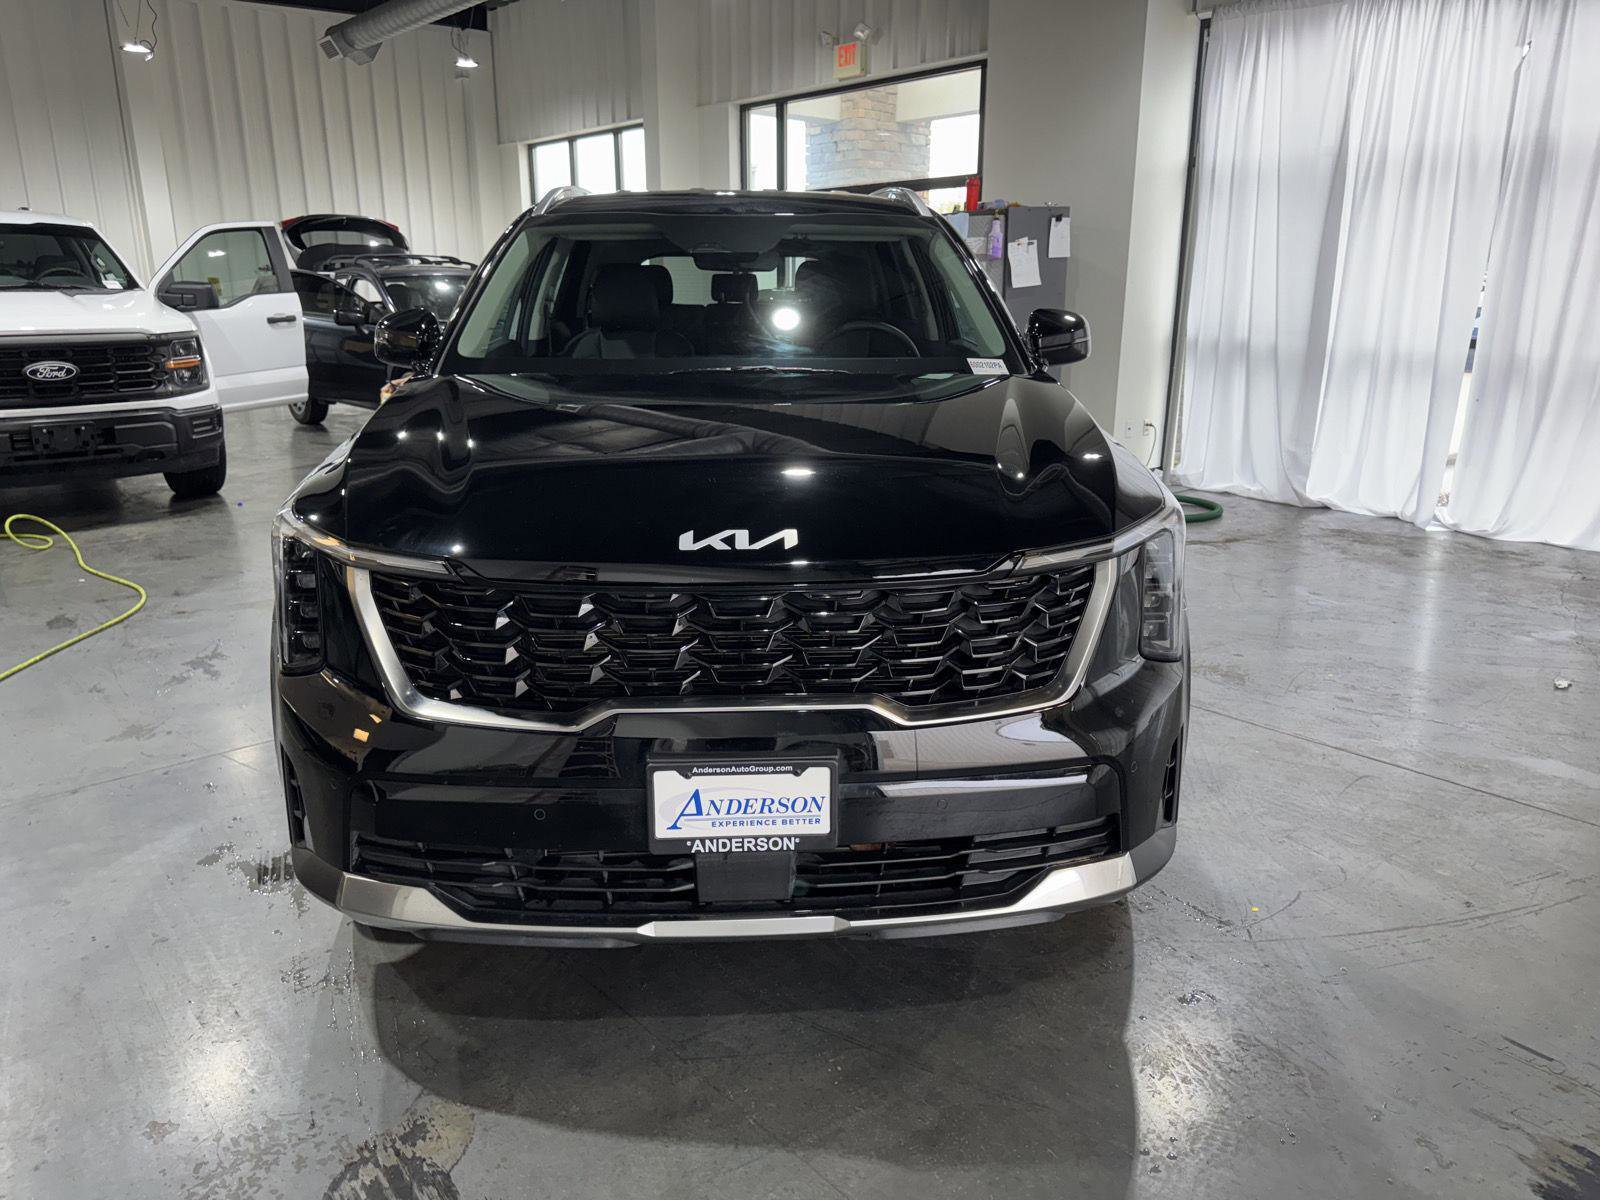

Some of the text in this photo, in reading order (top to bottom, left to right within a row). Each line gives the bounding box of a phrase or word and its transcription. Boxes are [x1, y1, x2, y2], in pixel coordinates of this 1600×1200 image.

[837, 43, 857, 68] EXIT
[37, 365, 67, 378] Ford
[678, 529, 799, 551] KIA
[692, 765, 793, 774] AndersonAutoGroup.com
[666, 788, 826, 830] ANDERSON
[711, 818, 821, 828] EXPERIENCE BETTER
